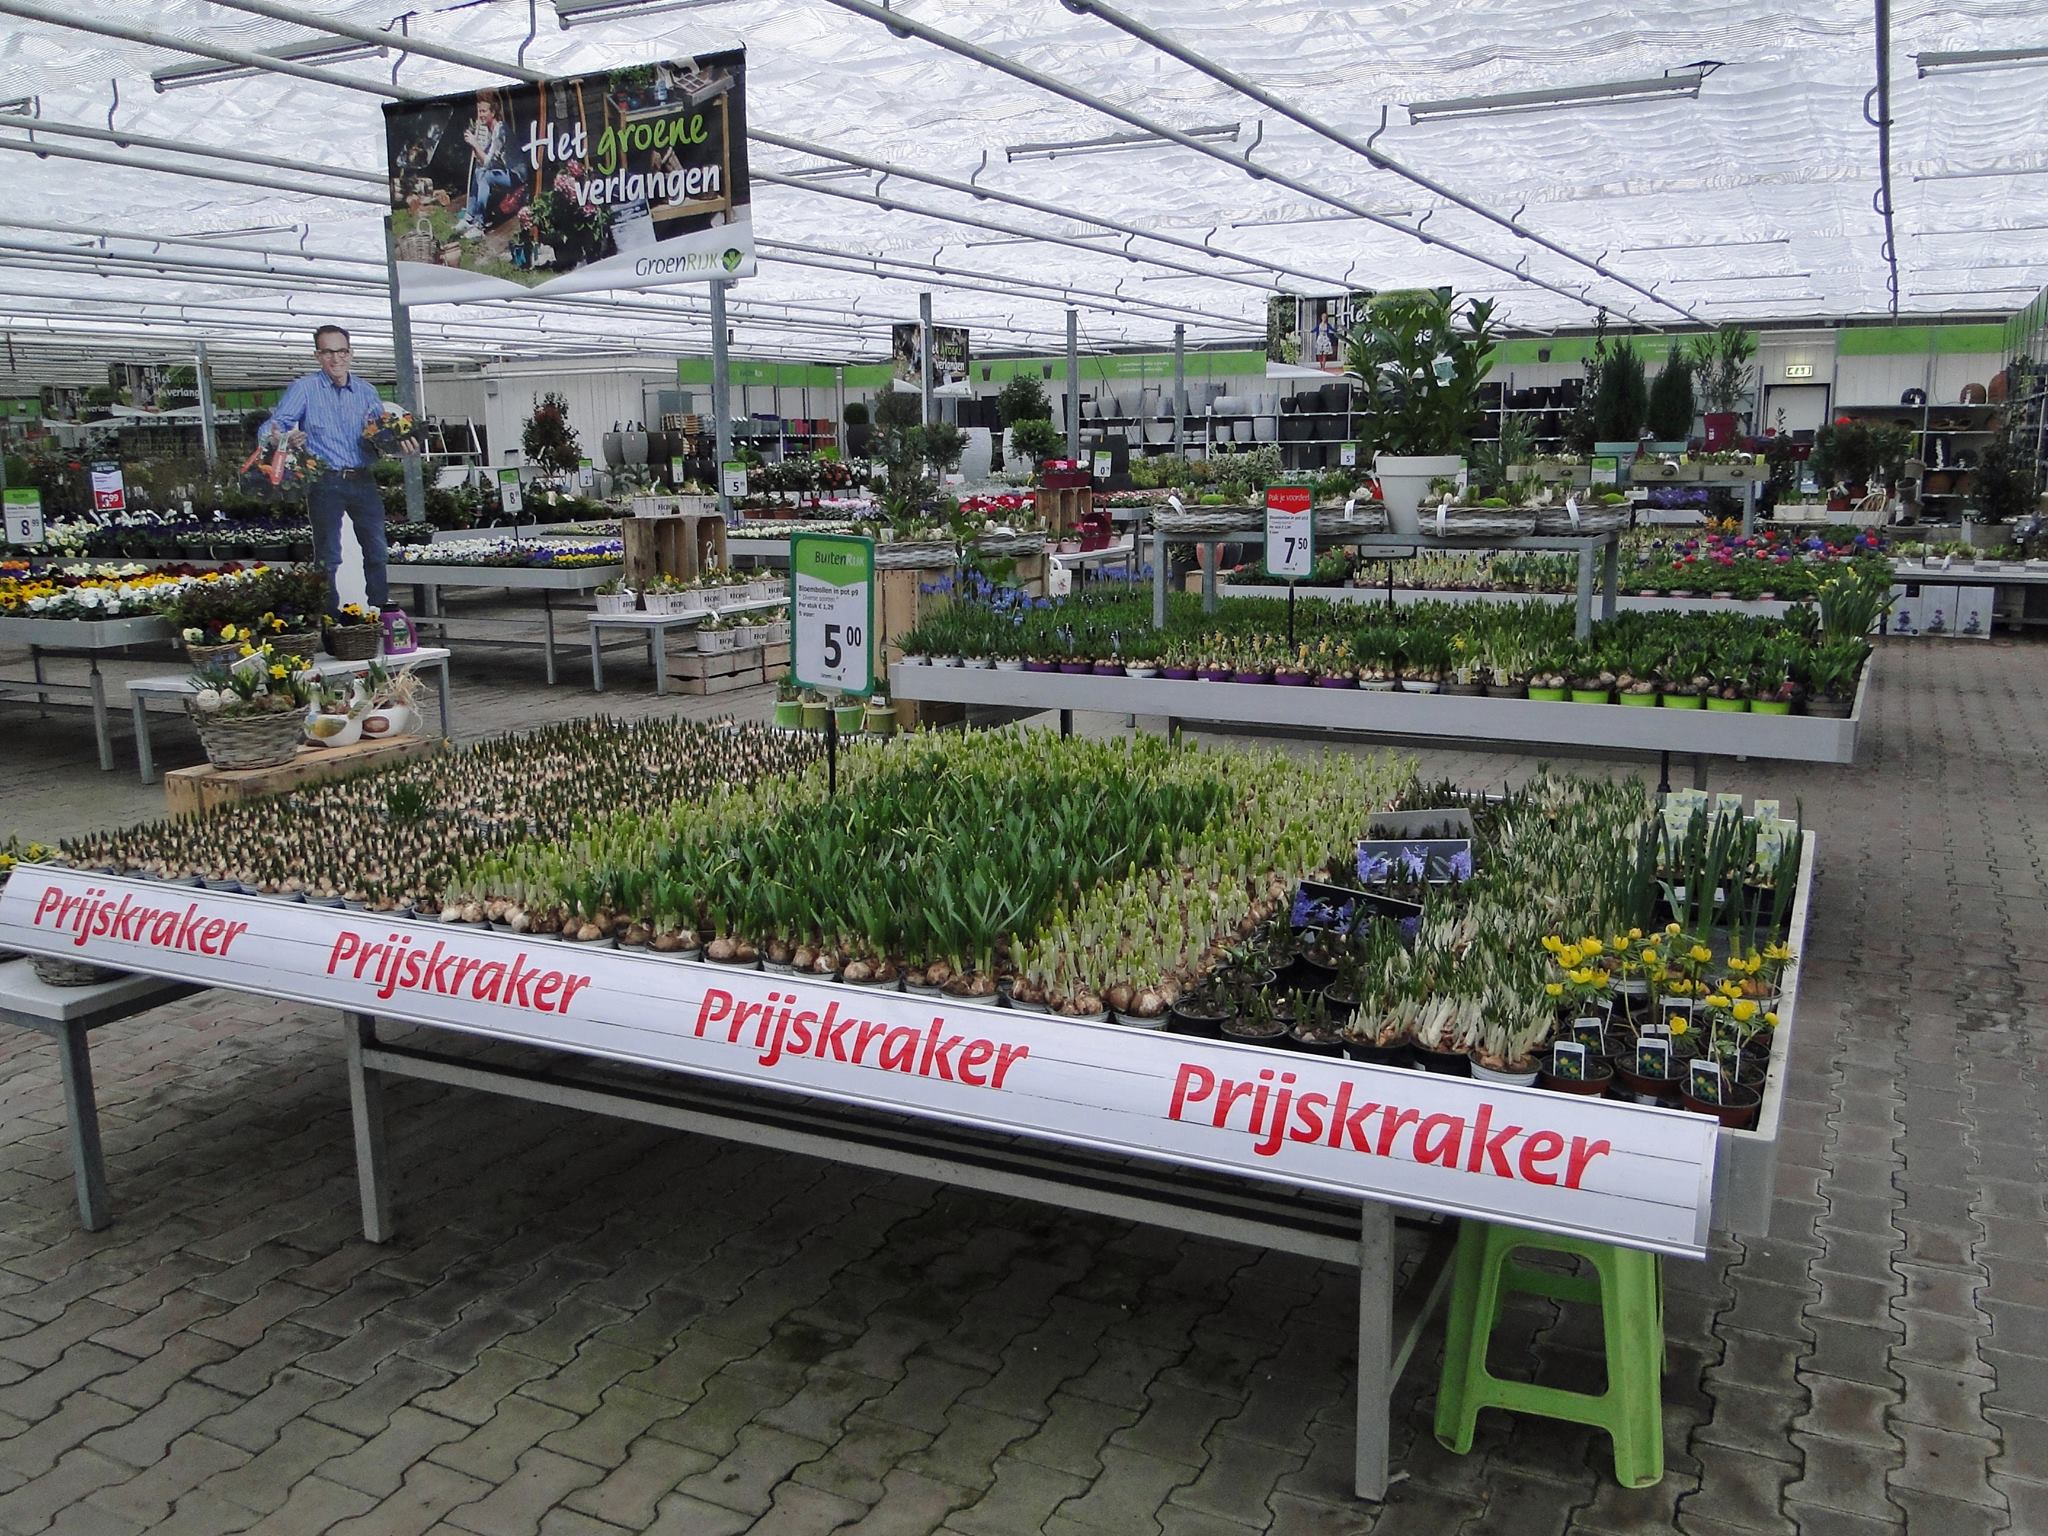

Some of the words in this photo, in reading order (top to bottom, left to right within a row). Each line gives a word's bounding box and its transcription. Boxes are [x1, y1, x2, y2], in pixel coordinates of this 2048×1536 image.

[521, 119, 587, 171] Het
[596, 112, 708, 176] groene
[575, 164, 721, 207] verlangen
[1336, 304, 1374, 324] Het
[167, 387, 200, 400] verlang
[798, 584, 832, 595] Bloembollen
[840, 589, 850, 597] pot
[34, 887, 247, 955] Prijskraker
[327, 932, 591, 1014] Prijskraker
[694, 988, 1029, 1089] Prijskraker
[1168, 1063, 1611, 1189] Prijskraker
